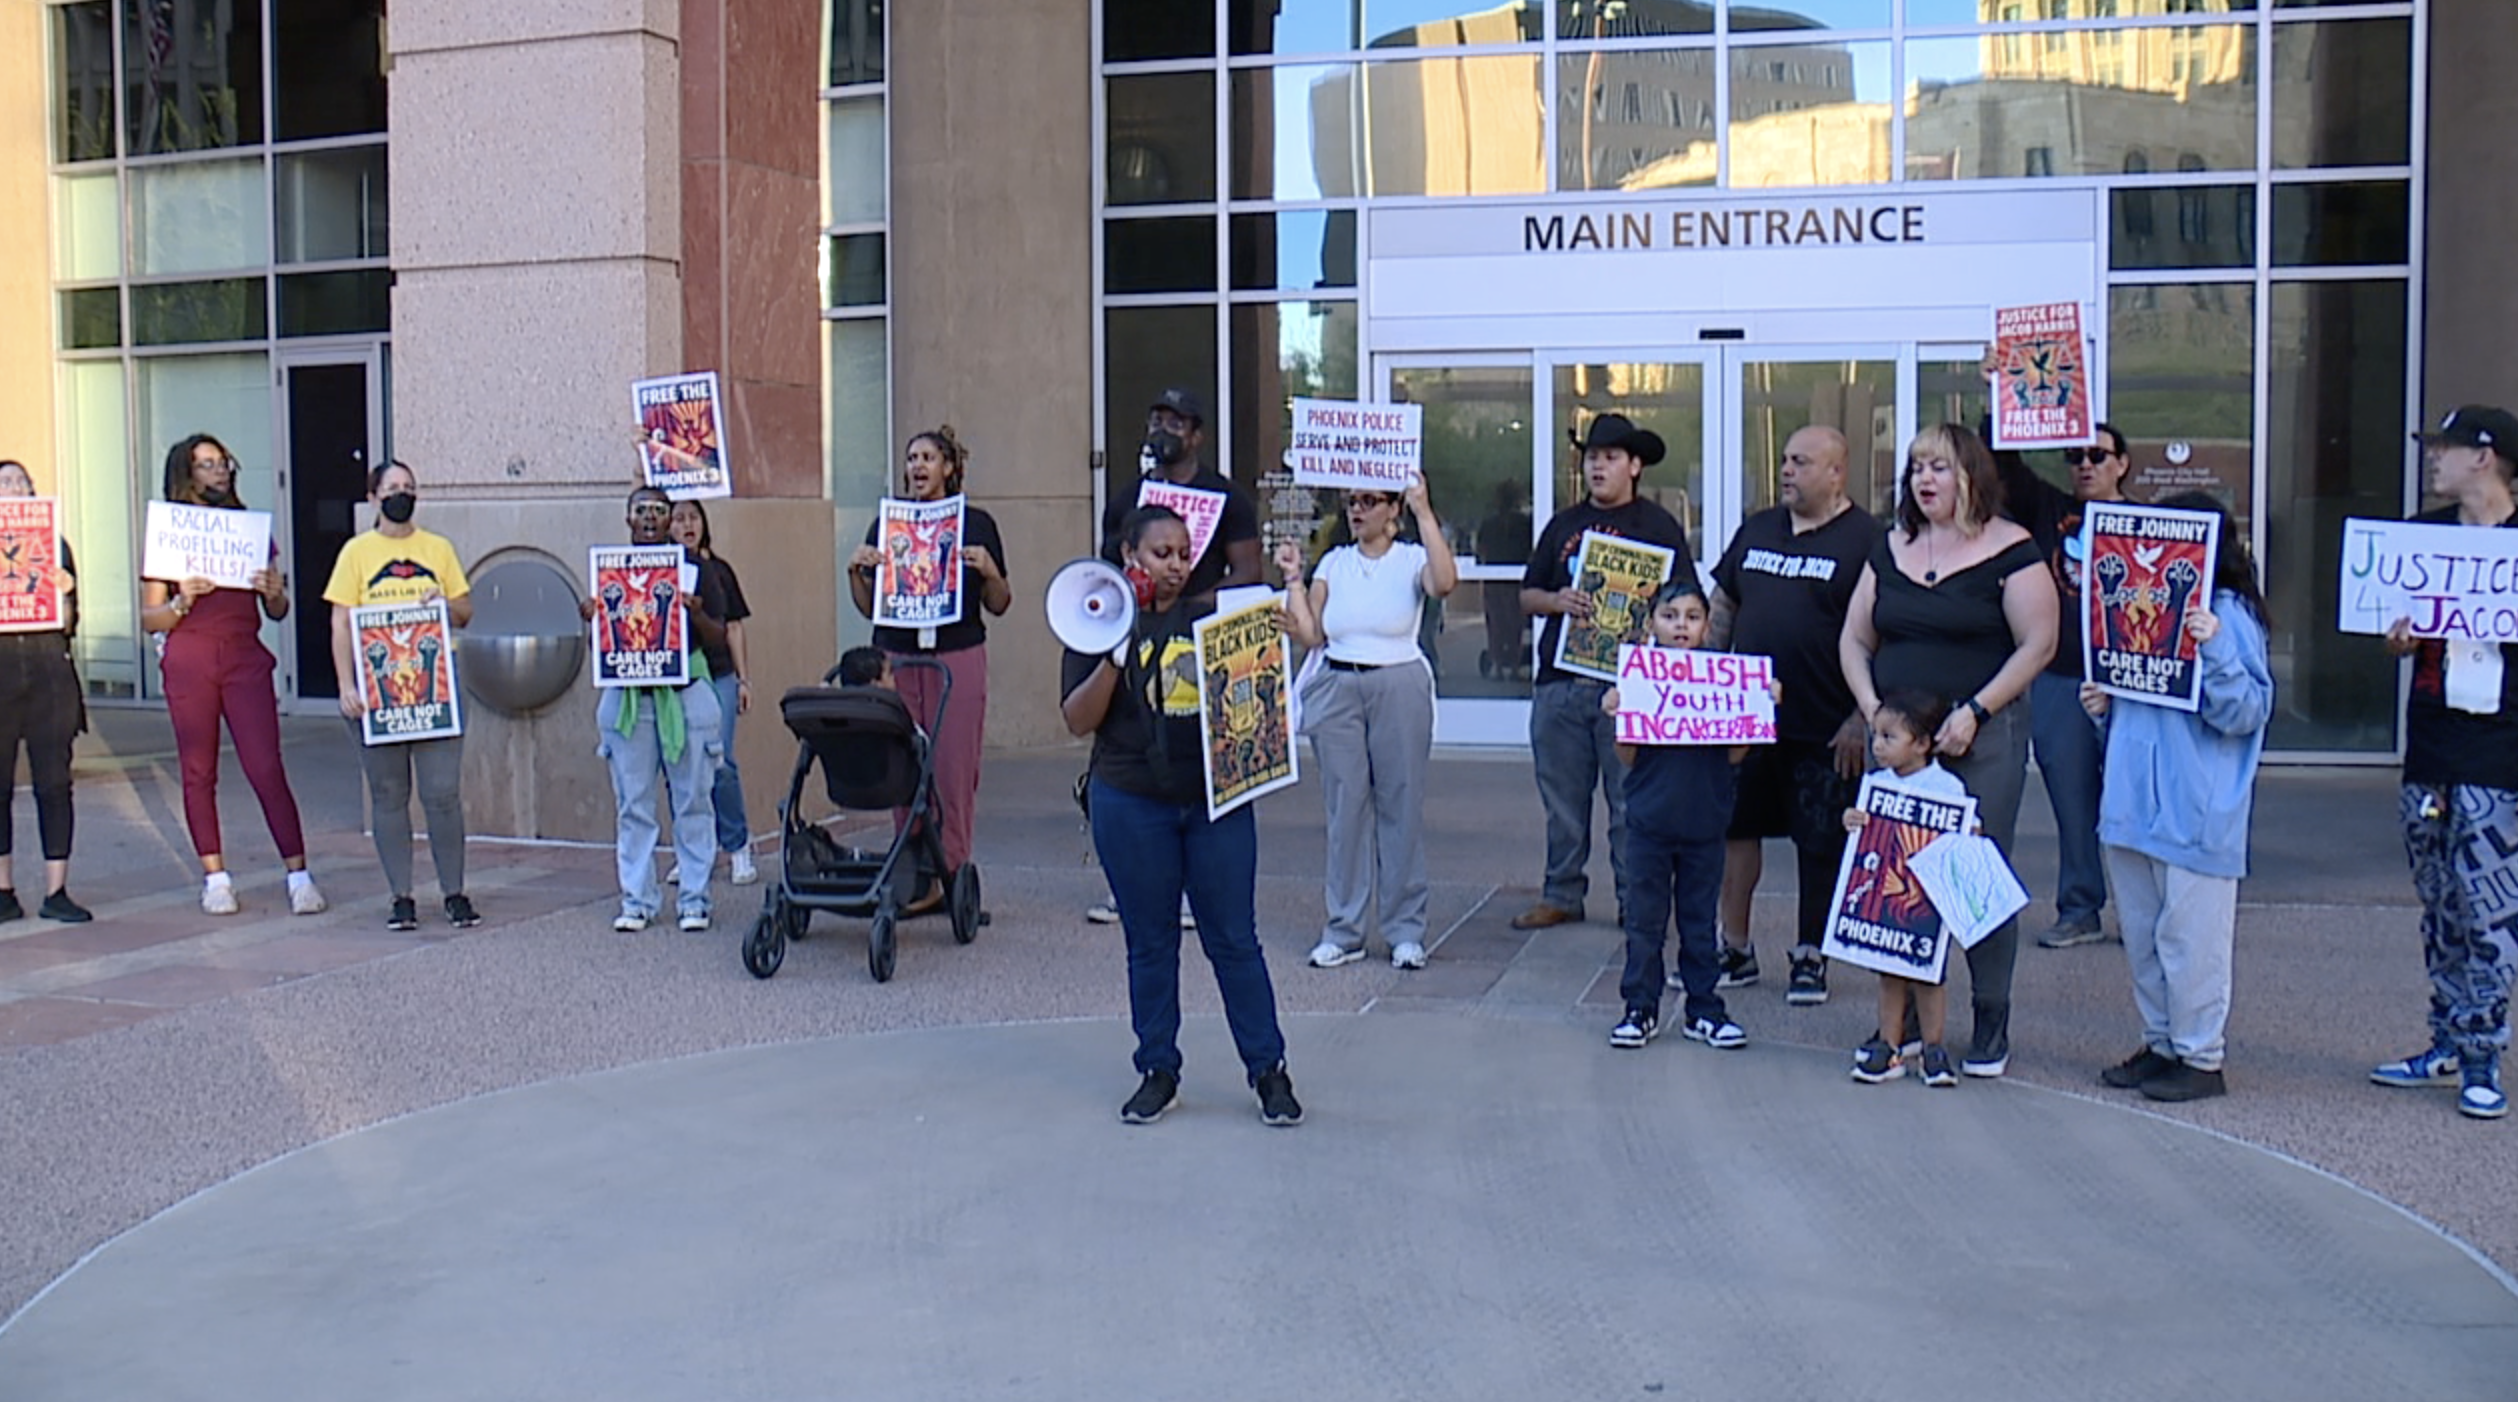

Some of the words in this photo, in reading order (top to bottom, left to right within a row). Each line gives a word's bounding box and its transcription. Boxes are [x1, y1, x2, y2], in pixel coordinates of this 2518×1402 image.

[1524, 211, 1651, 252] MAIN
[1672, 205, 1925, 248] ENTRANCE
[1999, 305, 2047, 324] JUSTICE
[2049, 303, 2075, 319] FOR
[1997, 322, 2033, 337] JACOB
[2034, 318, 2076, 333] HARRIS
[642, 384, 679, 404] FREE
[681, 381, 709, 400] THE
[1307, 408, 1359, 429] PHOENIX
[1361, 411, 1404, 432] POLICE
[2004, 408, 2041, 424] FREE
[2042, 406, 2067, 422] THE
[2002, 419, 2068, 438] PHOENIX
[2070, 419, 2079, 436] 3
[1295, 431, 1329, 450] SERVE
[1334, 435, 1360, 453] AND
[1363, 437, 1418, 457] PROTECT
[653, 468, 707, 488] PHOENIX
[709, 466, 720, 483] 3
[1301, 456, 1325, 474] KILL
[1329, 457, 1354, 475] AND
[1358, 460, 1411, 480] NEGLECT
[23, 503, 50, 517] FOR
[888, 507, 916, 520] FREE
[918, 503, 957, 521] JOHNNY
[1146, 489, 1221, 514] JUSTICE
[170, 506, 238, 534] RACIAL
[2096, 515, 2136, 537] FREE
[2136, 518, 2207, 542] JOHNNY
[157, 531, 254, 559] PROFILING
[185, 553, 247, 580] KILLS!
[599, 554, 626, 568] FREE
[630, 553, 676, 568] JOHNNY
[1585, 551, 1627, 573] BLACK
[1629, 560, 1662, 581] KIDS
[1742, 547, 1784, 575] JUSTICE
[1800, 555, 1836, 581] JACOB
[887, 594, 925, 608] CARE
[925, 591, 950, 607] NOT
[2355, 583, 2392, 634] 4
[359, 612, 388, 628] FREE
[391, 607, 440, 625] JOHNNY
[896, 606, 941, 620] CAGES
[2410, 595, 2518, 639] JACO
[1205, 631, 1243, 666] BLACK
[1244, 618, 1278, 652] KIDS
[605, 651, 642, 666] CARE
[645, 650, 674, 665] NOT
[2098, 649, 2144, 675] CARE
[2146, 655, 2185, 681] NOT
[616, 664, 663, 678] CAGES
[2109, 669, 2169, 694] CAGES
[375, 706, 414, 723] CARE
[415, 703, 442, 720] NOT
[386, 718, 434, 733] CAGES
[1869, 789, 1917, 822] FREE
[1919, 800, 1962, 833] THE
[1836, 915, 1917, 956] PHOENIX
[1916, 936, 1935, 958] 3
